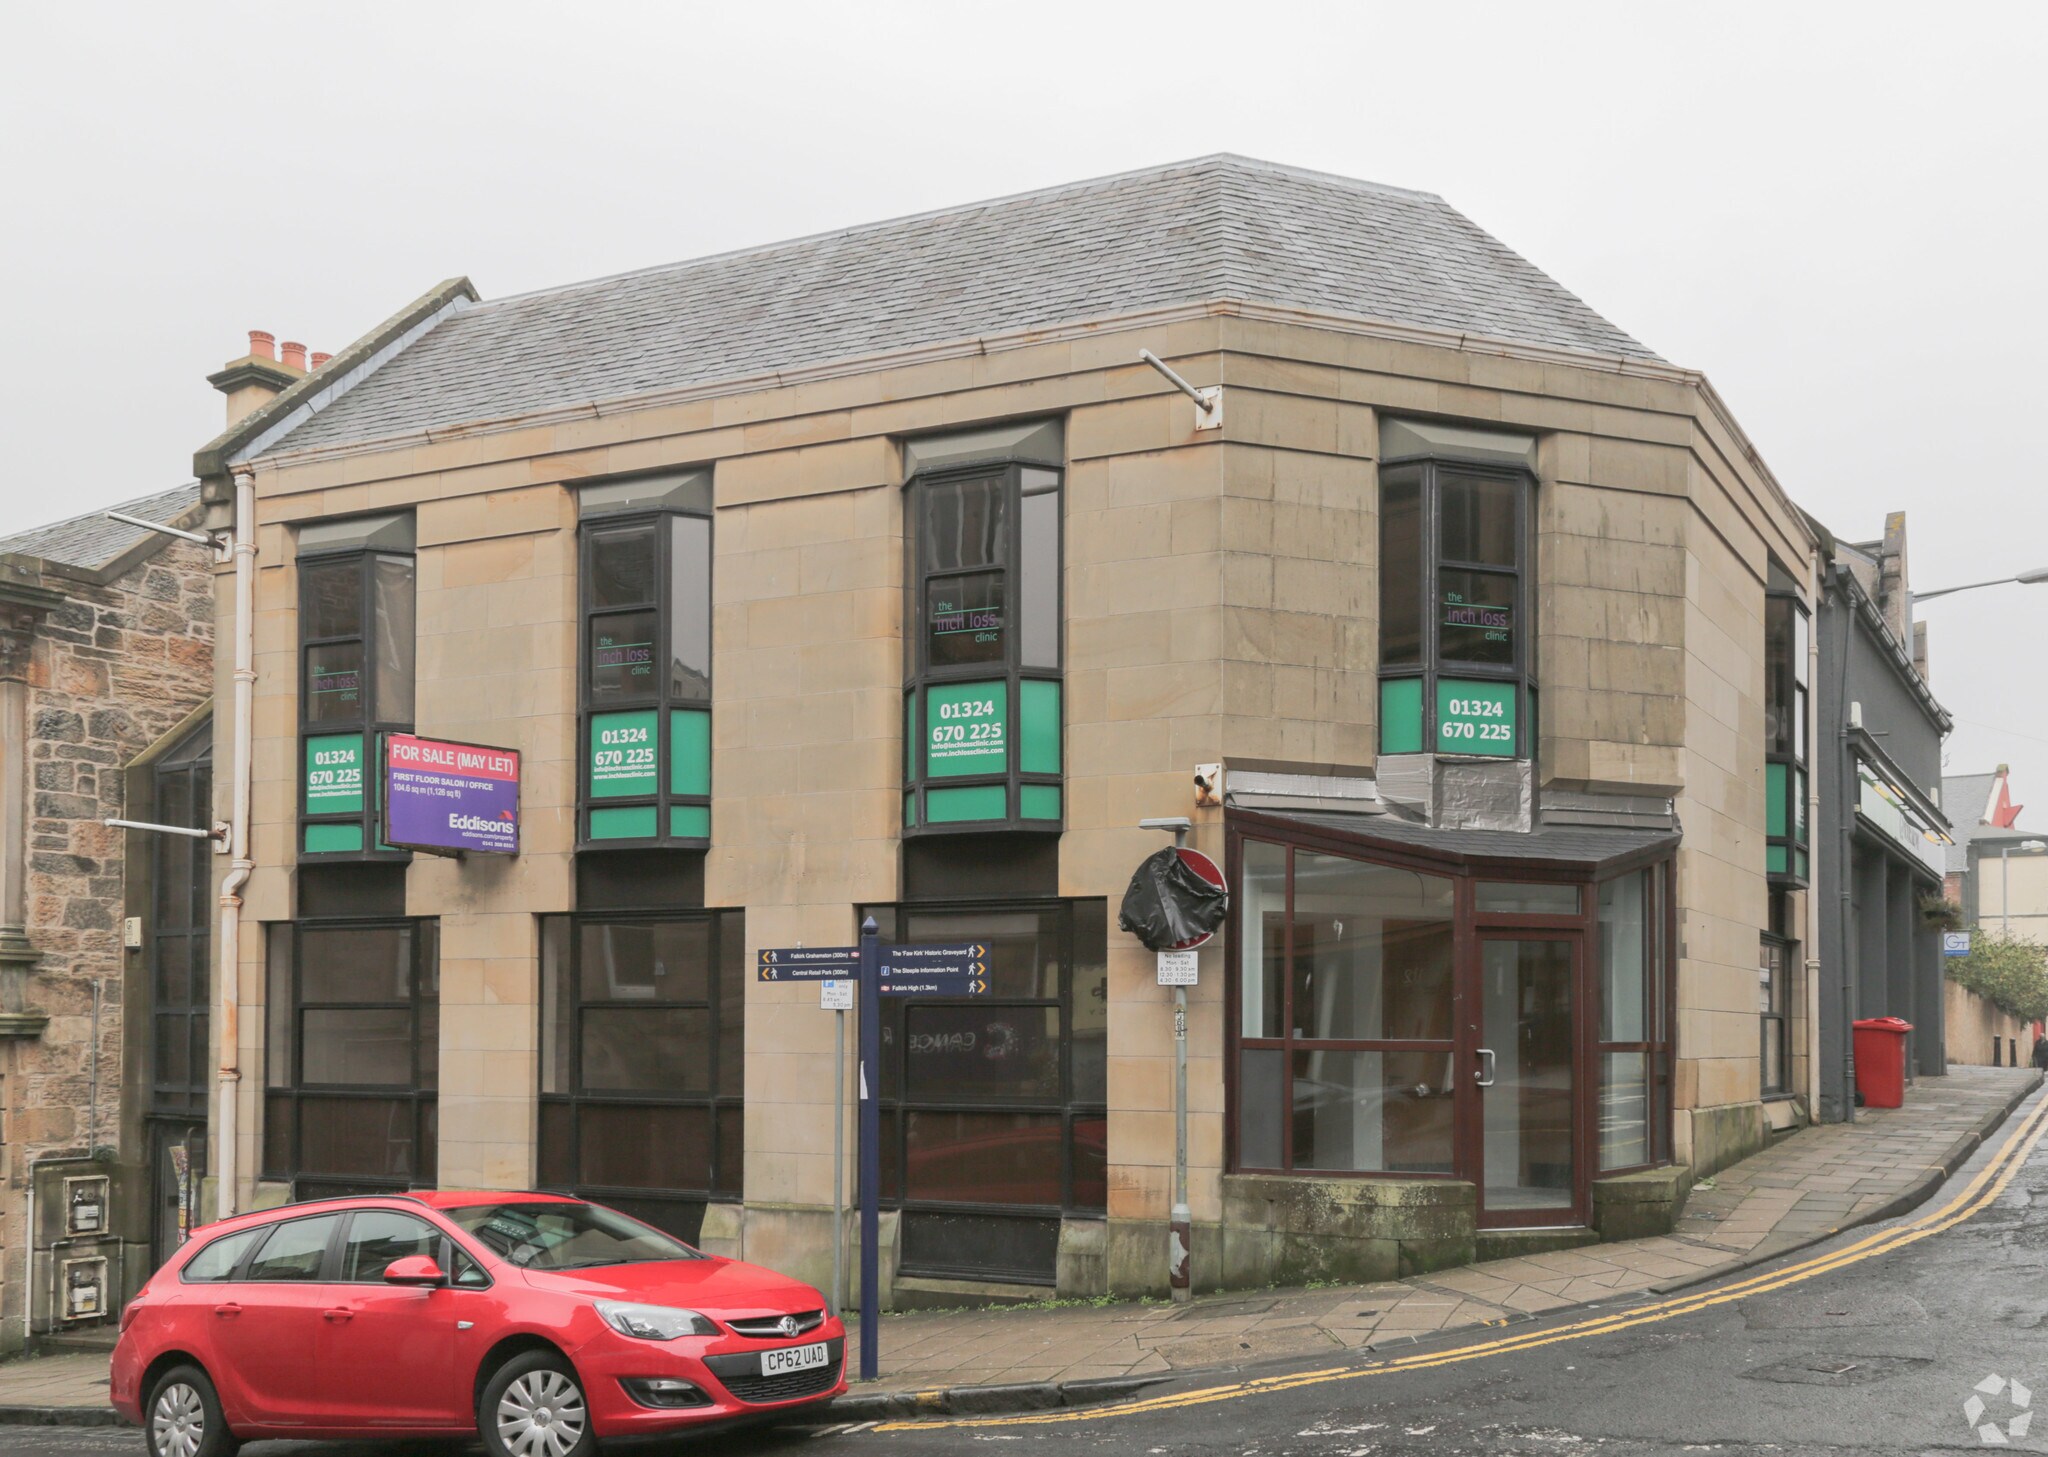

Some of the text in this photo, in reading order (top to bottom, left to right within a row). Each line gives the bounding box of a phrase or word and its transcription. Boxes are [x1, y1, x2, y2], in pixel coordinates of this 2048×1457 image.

[1448, 592, 1462, 602] the
[938, 601, 952, 611] the
[937, 612, 996, 632] inch loss
[1448, 607, 1506, 626] inch loss
[600, 636, 612, 646] the
[975, 632, 998, 643] clinic
[1485, 630, 1507, 642] clinic
[599, 648, 650, 664] inch loss
[314, 666, 324, 674] the
[632, 665, 650, 676] clinic
[312, 676, 356, 690] inch loss
[340, 692, 357, 701] clinic
[940, 700, 994, 719] 01324
[1449, 699, 1503, 717] 01324
[601, 728, 648, 744] 01324
[932, 722, 1002, 742] 670 225
[1442, 722, 1510, 740] 670 225
[315, 750, 356, 765] 01324
[393, 744, 514, 776] FOR SALE (MAY LET)
[595, 748, 654, 766] 670 225
[310, 768, 360, 784] 670 225
[393, 772, 414, 782] FIRST
[415, 774, 440, 784] FLOOR
[440, 777, 465, 787] SALON
[469, 781, 494, 791] OFFICE
[393, 784, 410, 792] 104.6
[411, 786, 419, 794] sq
[446, 790, 454, 798] sq
[449, 813, 514, 834] Eddisons
[768, 1346, 824, 1370] CP62 UAD
